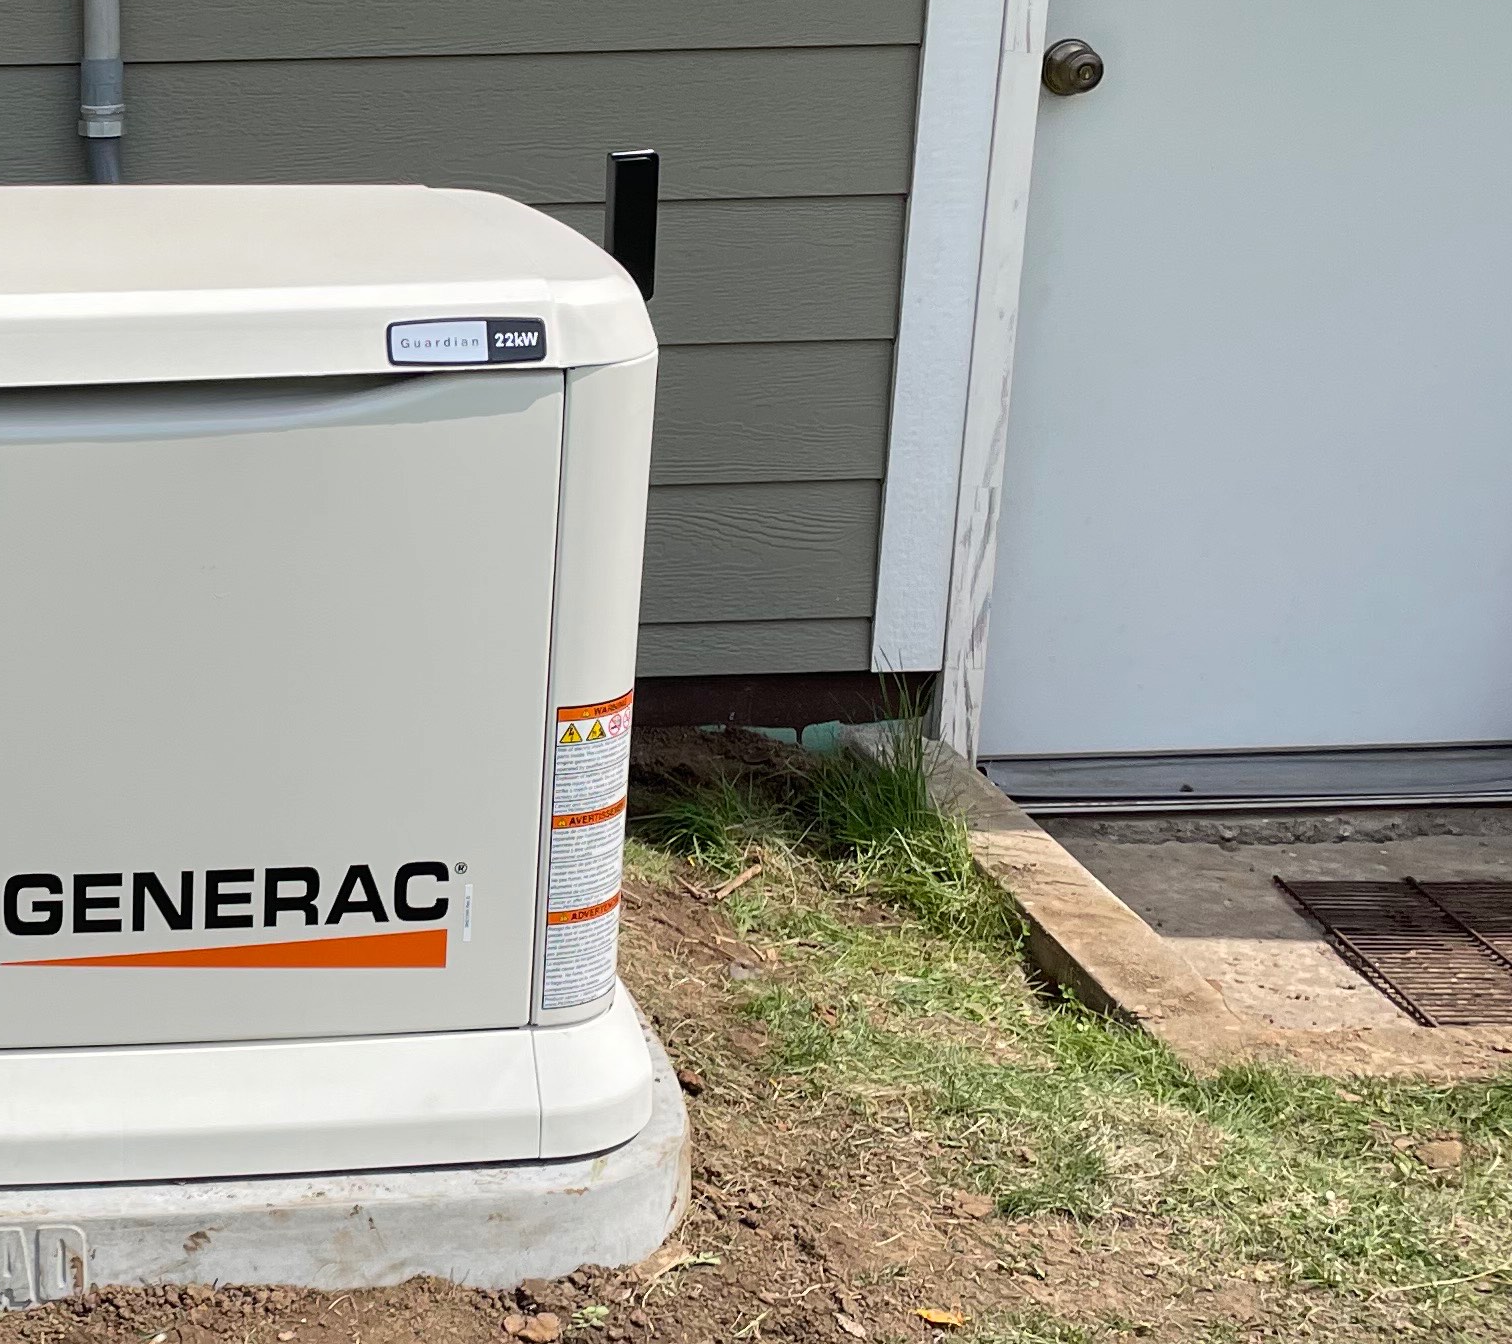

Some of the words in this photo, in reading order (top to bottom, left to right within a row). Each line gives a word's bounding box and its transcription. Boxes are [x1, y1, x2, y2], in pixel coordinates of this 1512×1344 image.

[400, 338, 480, 349] Guardian
[493, 331, 539, 348] 22kW
[2, 861, 450, 936] GENERAC
[569, 899, 620, 921] ADVERTEN
